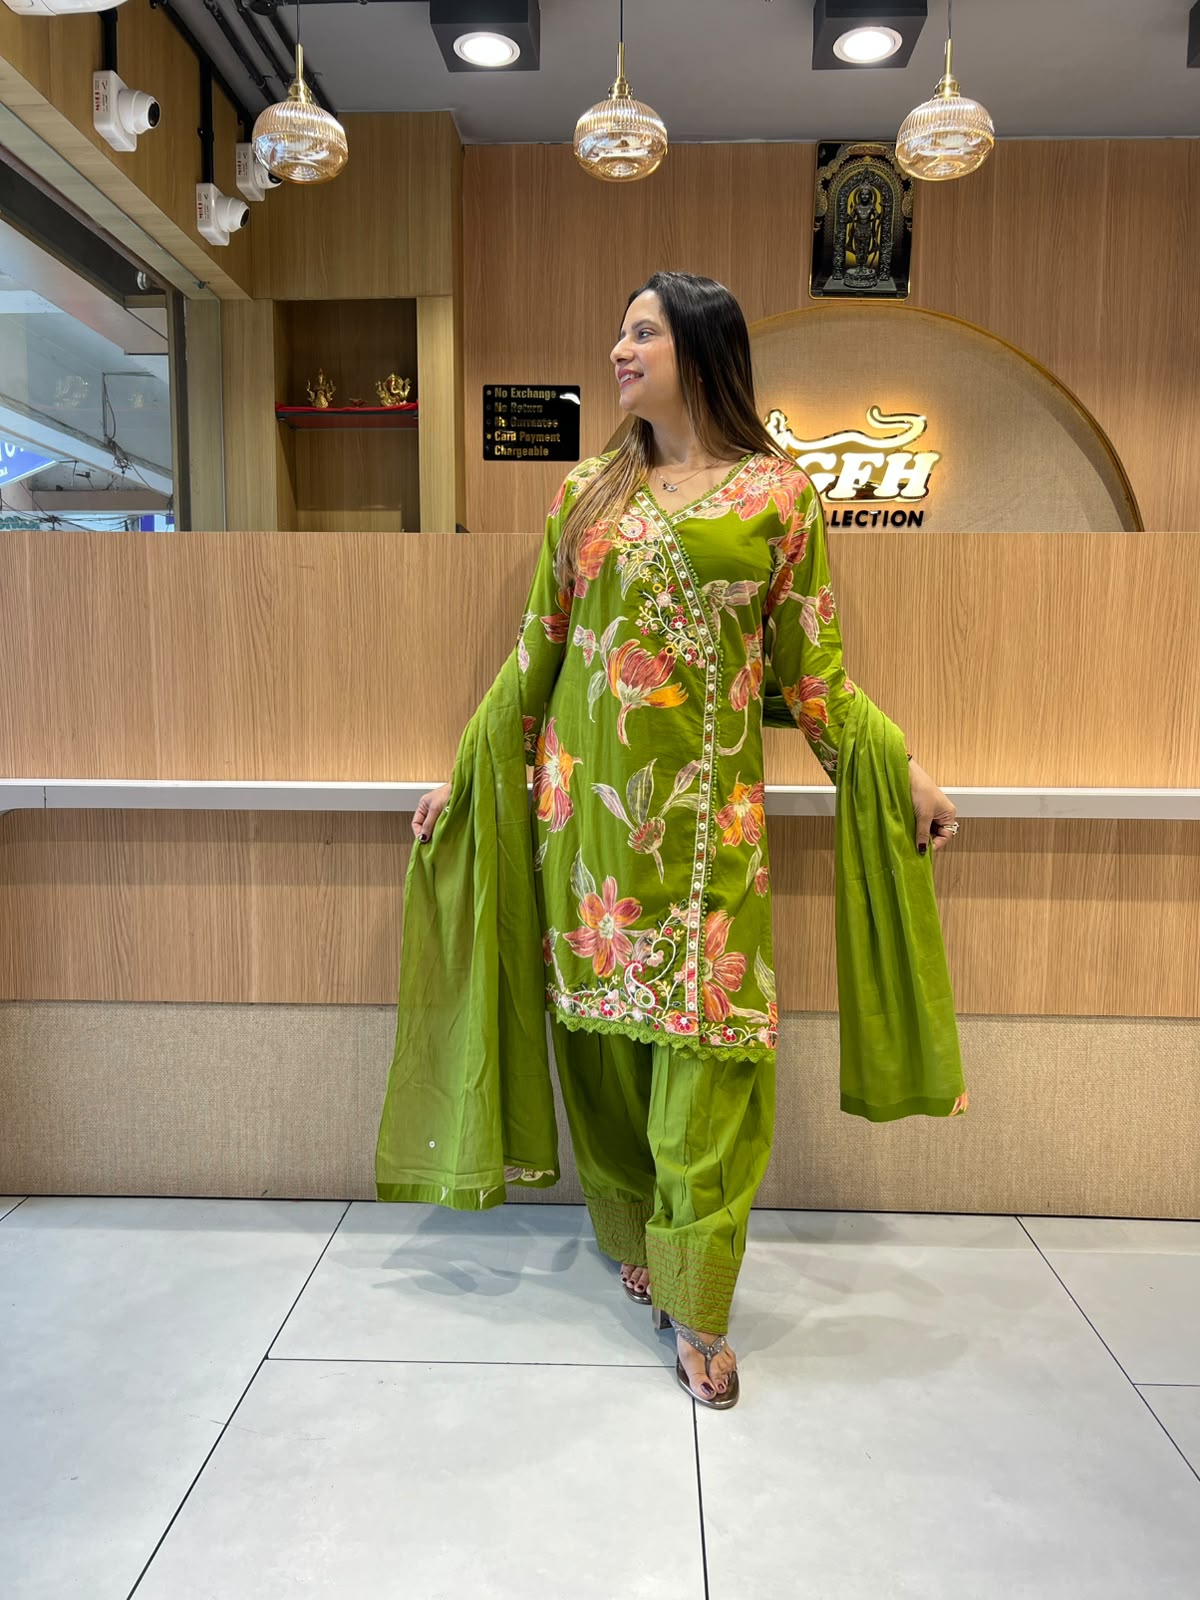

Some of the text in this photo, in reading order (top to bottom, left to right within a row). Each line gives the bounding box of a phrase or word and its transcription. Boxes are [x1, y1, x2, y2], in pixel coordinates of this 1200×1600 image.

[494, 387, 557, 401] No Exchange
[494, 402, 543, 413] No Return
[494, 416, 508, 427] No
[494, 430, 561, 444] Card Payment
[494, 445, 549, 458] Chargeable
[825, 510, 925, 528] LECTION
